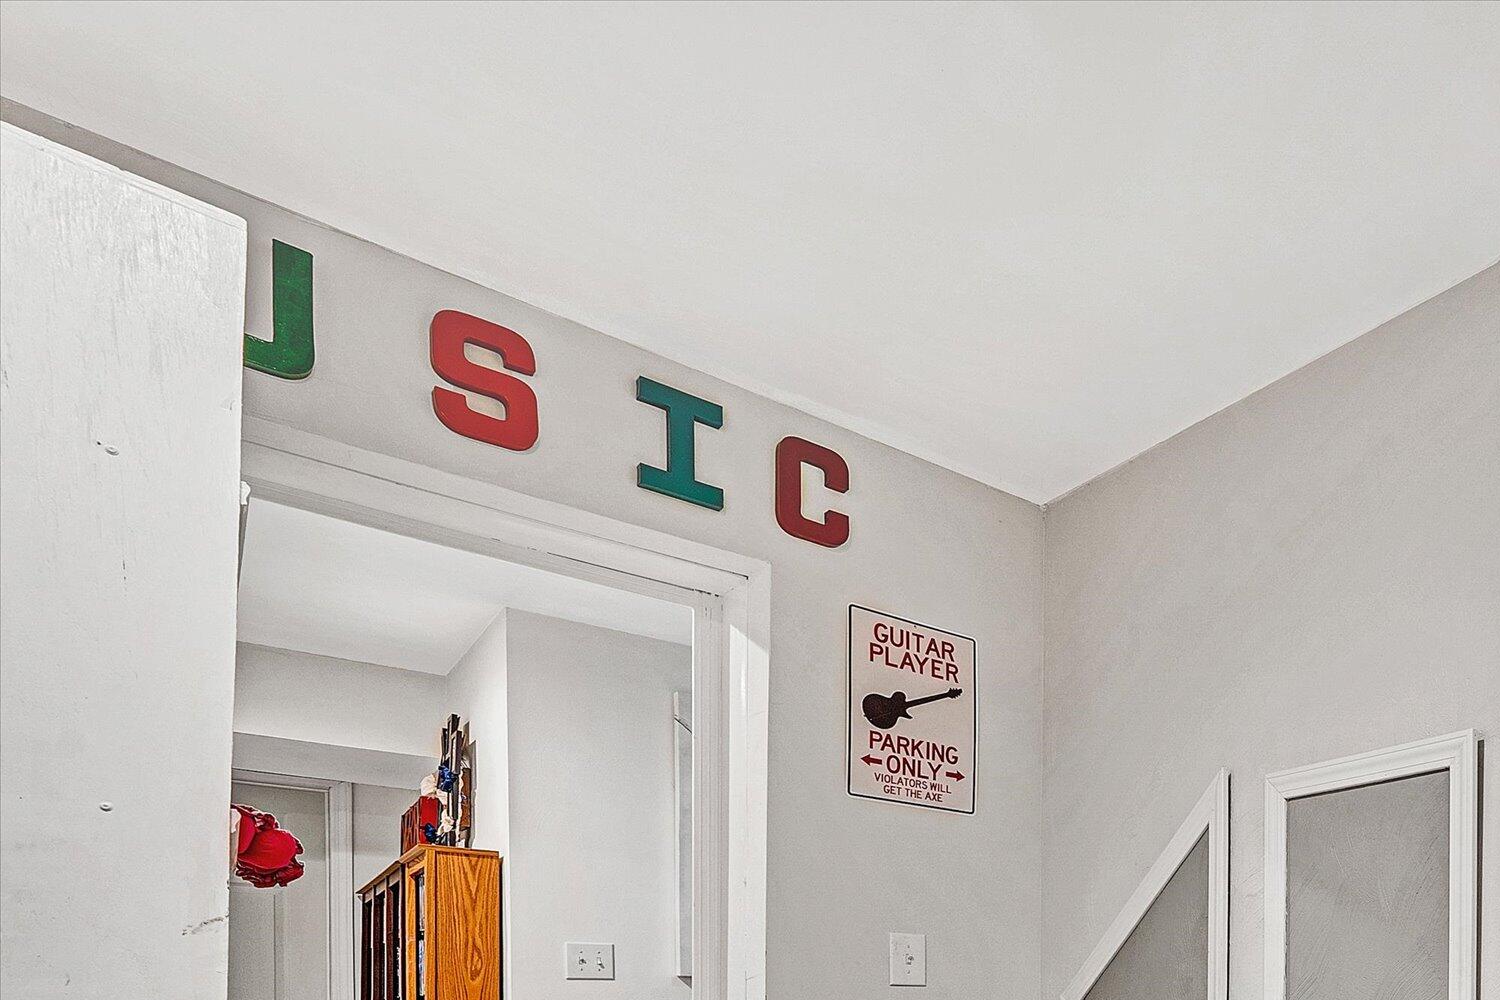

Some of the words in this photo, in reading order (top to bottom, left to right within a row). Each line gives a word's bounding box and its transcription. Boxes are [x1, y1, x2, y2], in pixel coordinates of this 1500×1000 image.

[873, 622, 955, 662] GUITAR
[869, 642, 959, 683] PLAYER
[869, 730, 959, 764] PARKING
[886, 754, 942, 781] ONLY
[874, 772, 929, 790] VIOLATORS
[929, 781, 952, 794] WILL
[883, 785, 903, 796] GET
[904, 787, 923, 800] THE
[924, 792, 944, 803] AXE
